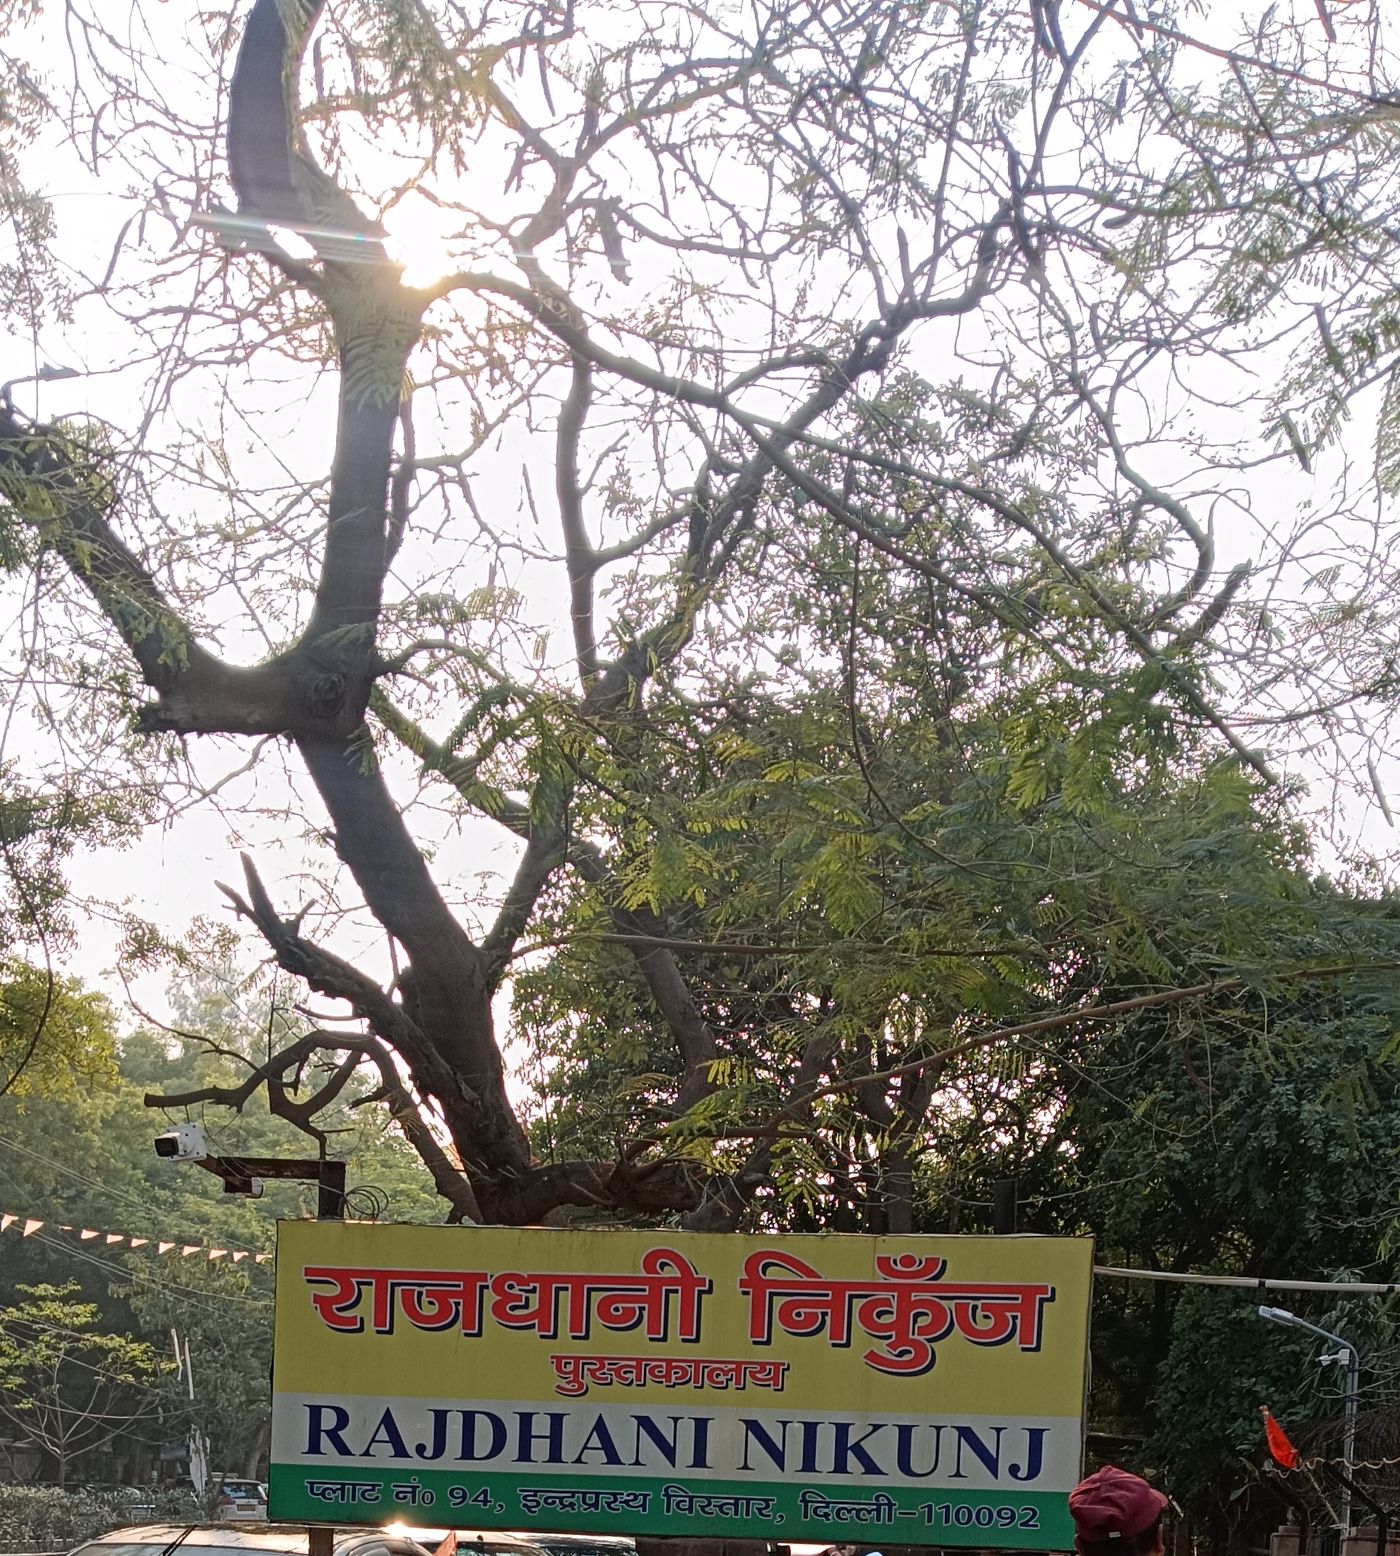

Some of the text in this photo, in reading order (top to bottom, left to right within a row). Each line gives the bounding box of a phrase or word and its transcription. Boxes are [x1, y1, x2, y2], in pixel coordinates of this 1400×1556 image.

[303, 1247, 1056, 1376] राजधानी निकुँज
[550, 1354, 790, 1397] पुस्तकालय
[302, 1403, 1052, 1481] RAJDHANI NIKUNJ
[304, 1479, 383, 1503] प्लाट
[447, 1485, 506, 1514] 94,
[517, 1487, 651, 1515] इन्द्रप्रस्थ
[661, 1484, 786, 1525] विस्तार,
